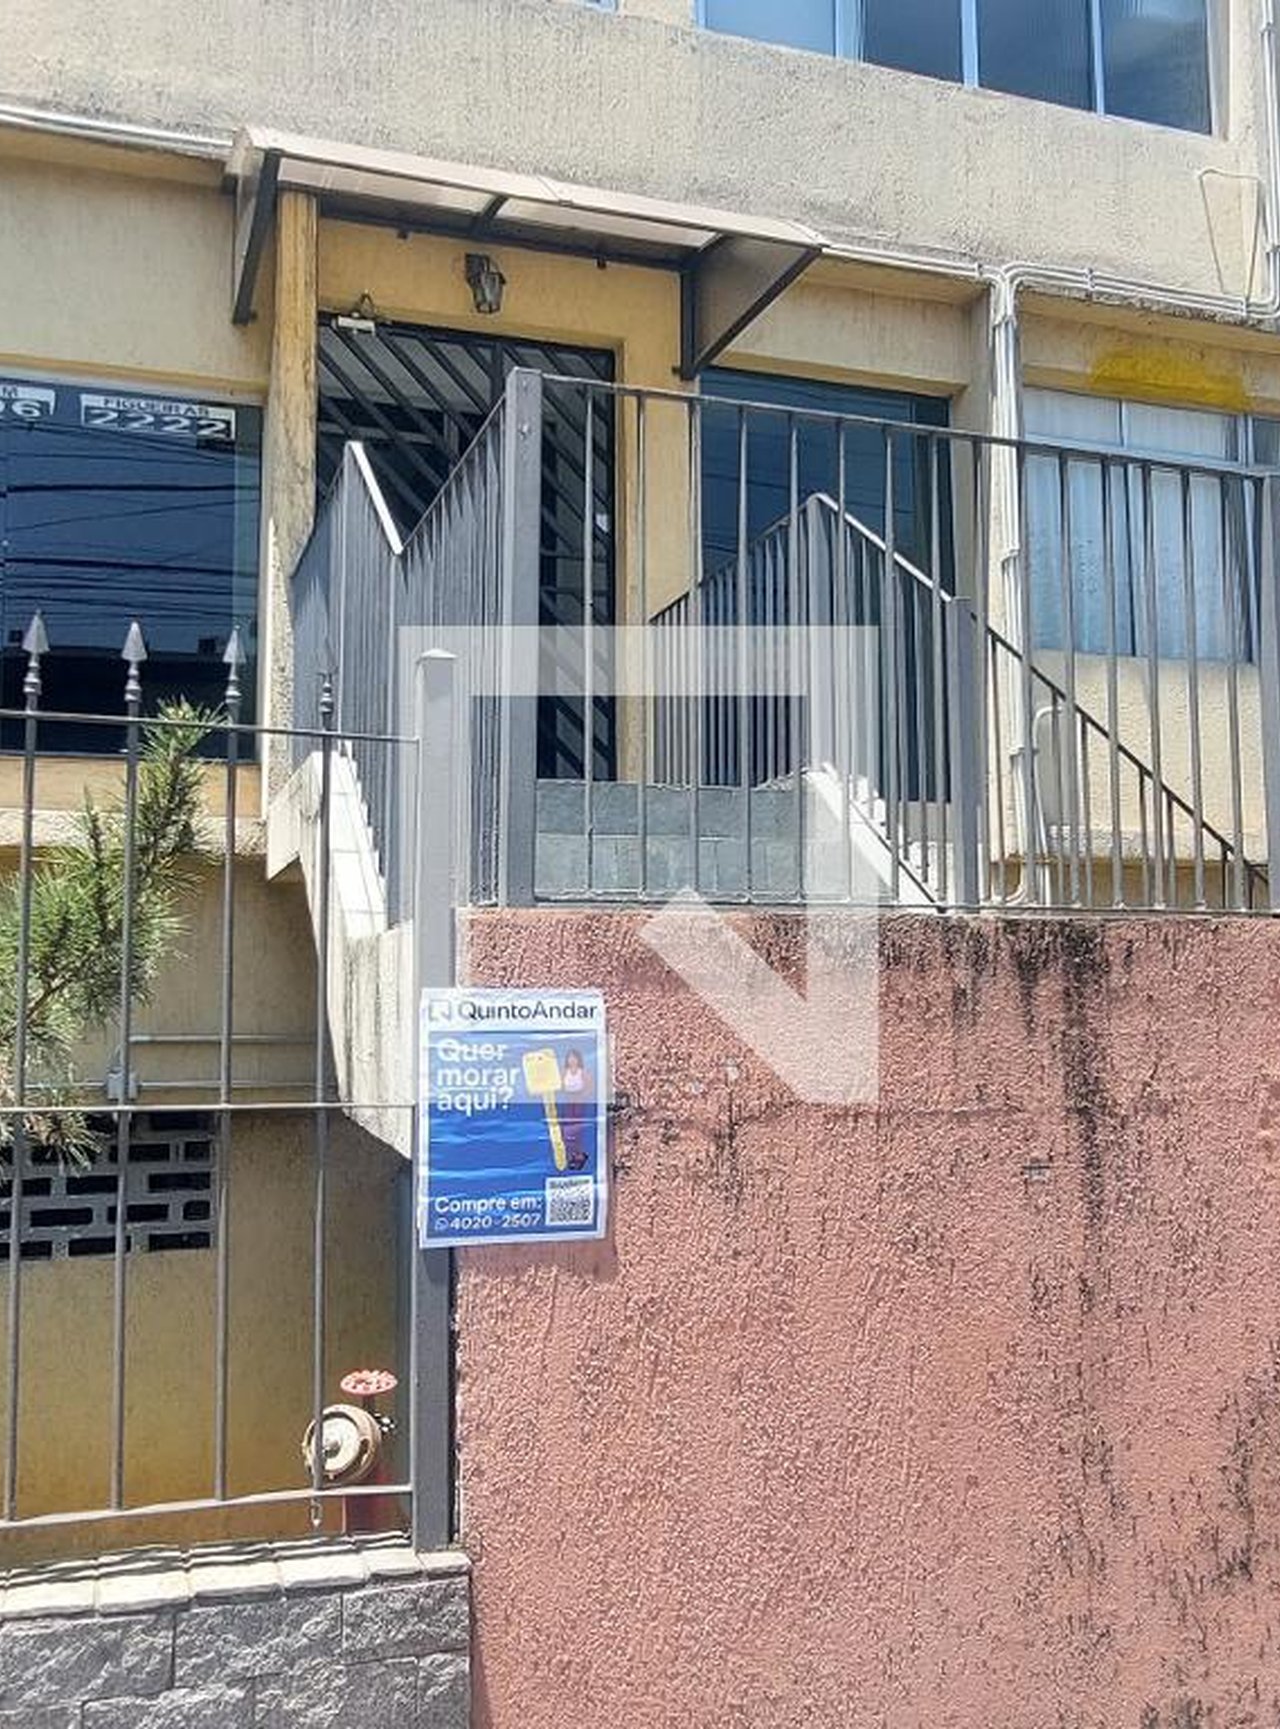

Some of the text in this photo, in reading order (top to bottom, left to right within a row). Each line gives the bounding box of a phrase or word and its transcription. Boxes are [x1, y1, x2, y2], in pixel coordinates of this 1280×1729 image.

[88, 408, 228, 438] 2222
[458, 1000, 599, 1021] QuintoAndar
[436, 1038, 508, 1063] Quer
[436, 1066, 520, 1087] morar
[436, 1086, 514, 1117] aqui?
[434, 1195, 543, 1215] Compre em:
